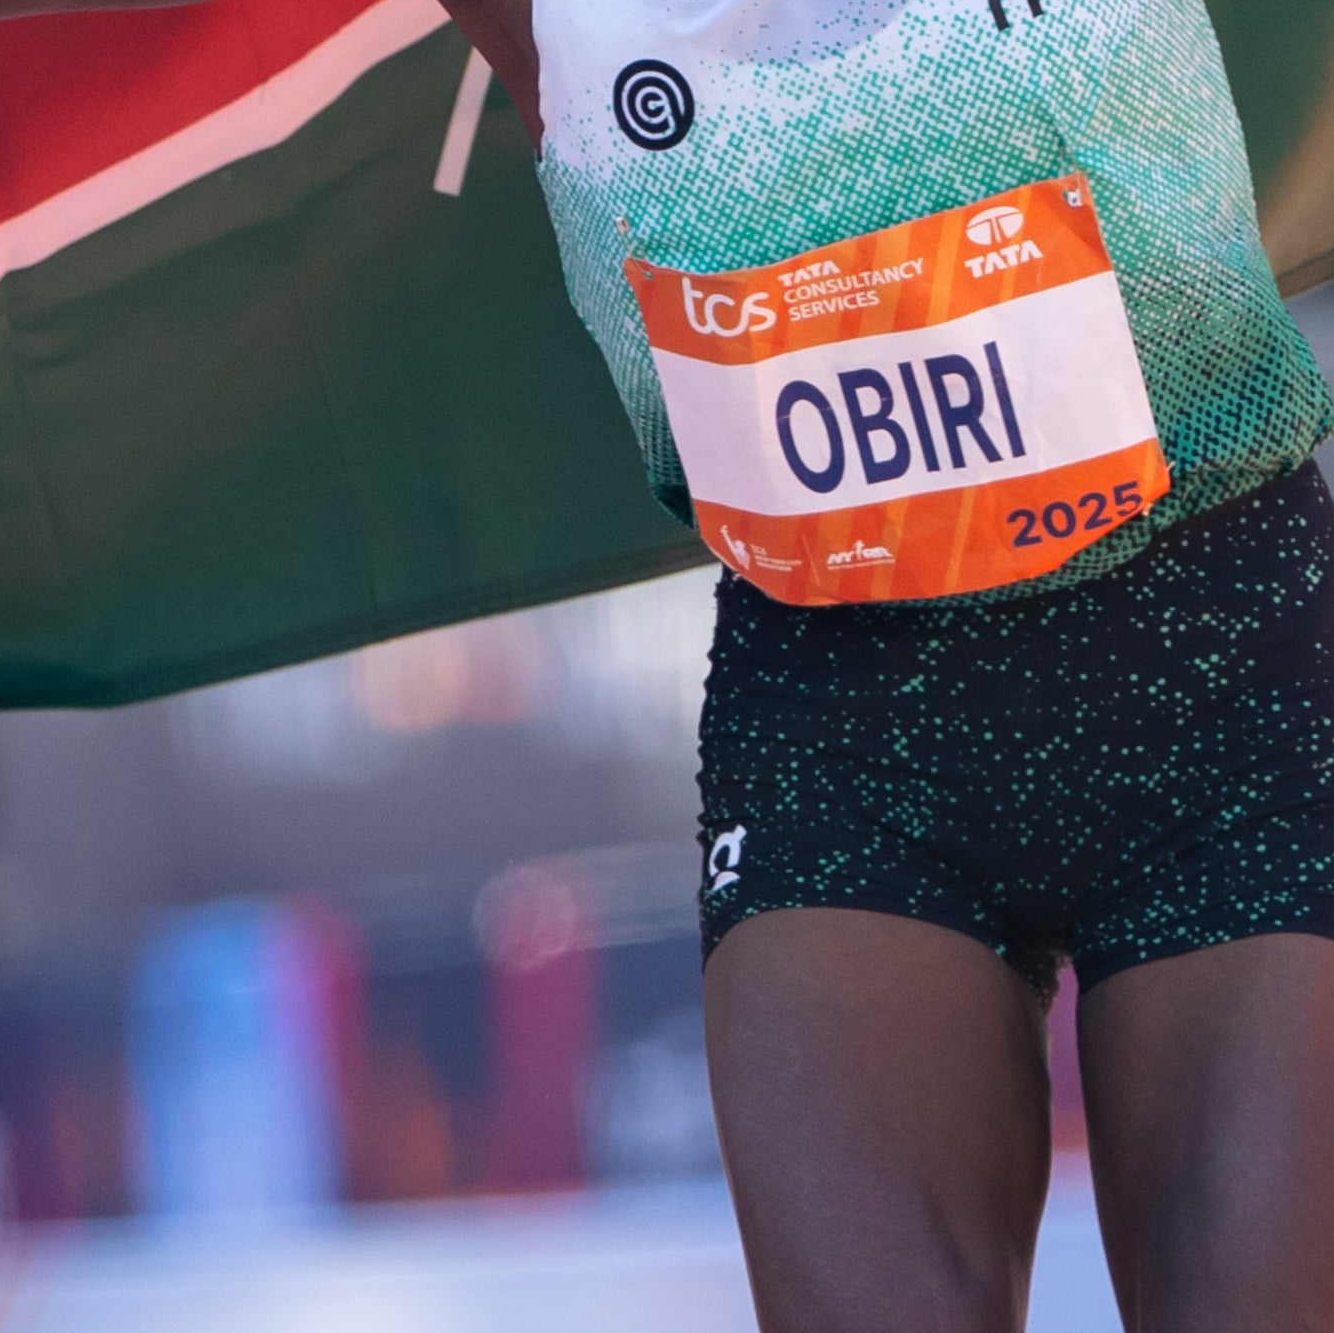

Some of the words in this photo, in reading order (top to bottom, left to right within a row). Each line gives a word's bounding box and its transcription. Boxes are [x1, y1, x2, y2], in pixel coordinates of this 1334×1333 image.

[778, 260, 841, 288] TATA
[782, 258, 924, 304] CONSULTANCY
[963, 240, 1043, 278] TATA
[680, 276, 777, 338] tcs
[787, 290, 880, 323] SERVICES
[776, 341, 1026, 495] OBIRI
[1006, 481, 1143, 548] 2025
